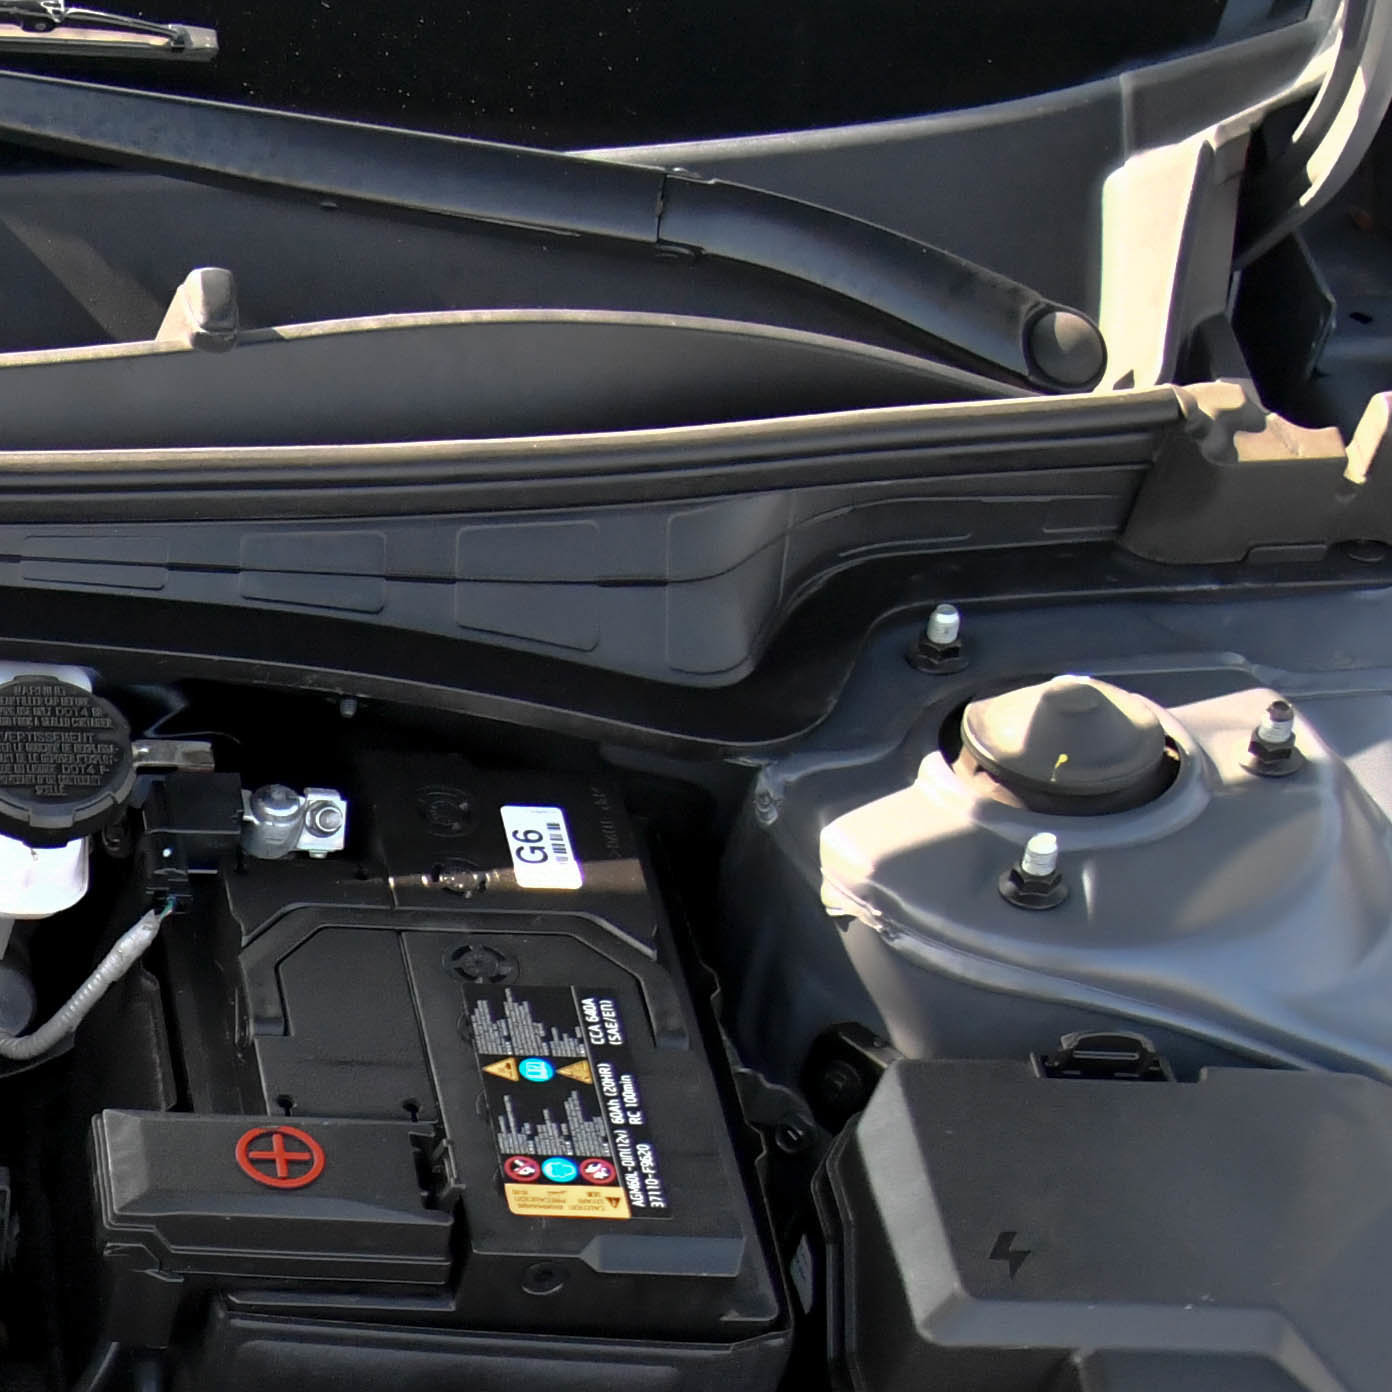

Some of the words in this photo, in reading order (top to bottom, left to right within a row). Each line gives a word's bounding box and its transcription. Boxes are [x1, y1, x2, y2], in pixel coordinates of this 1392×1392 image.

[512, 830, 549, 864] G6
[582, 997, 600, 1022] 640A
[589, 1025, 606, 1046] CCA
[597, 1062, 617, 1097] (20HR)
[621, 1074, 639, 1108] 100min
[607, 1098, 625, 1125] 60Ah
[629, 1110, 644, 1125] RC
